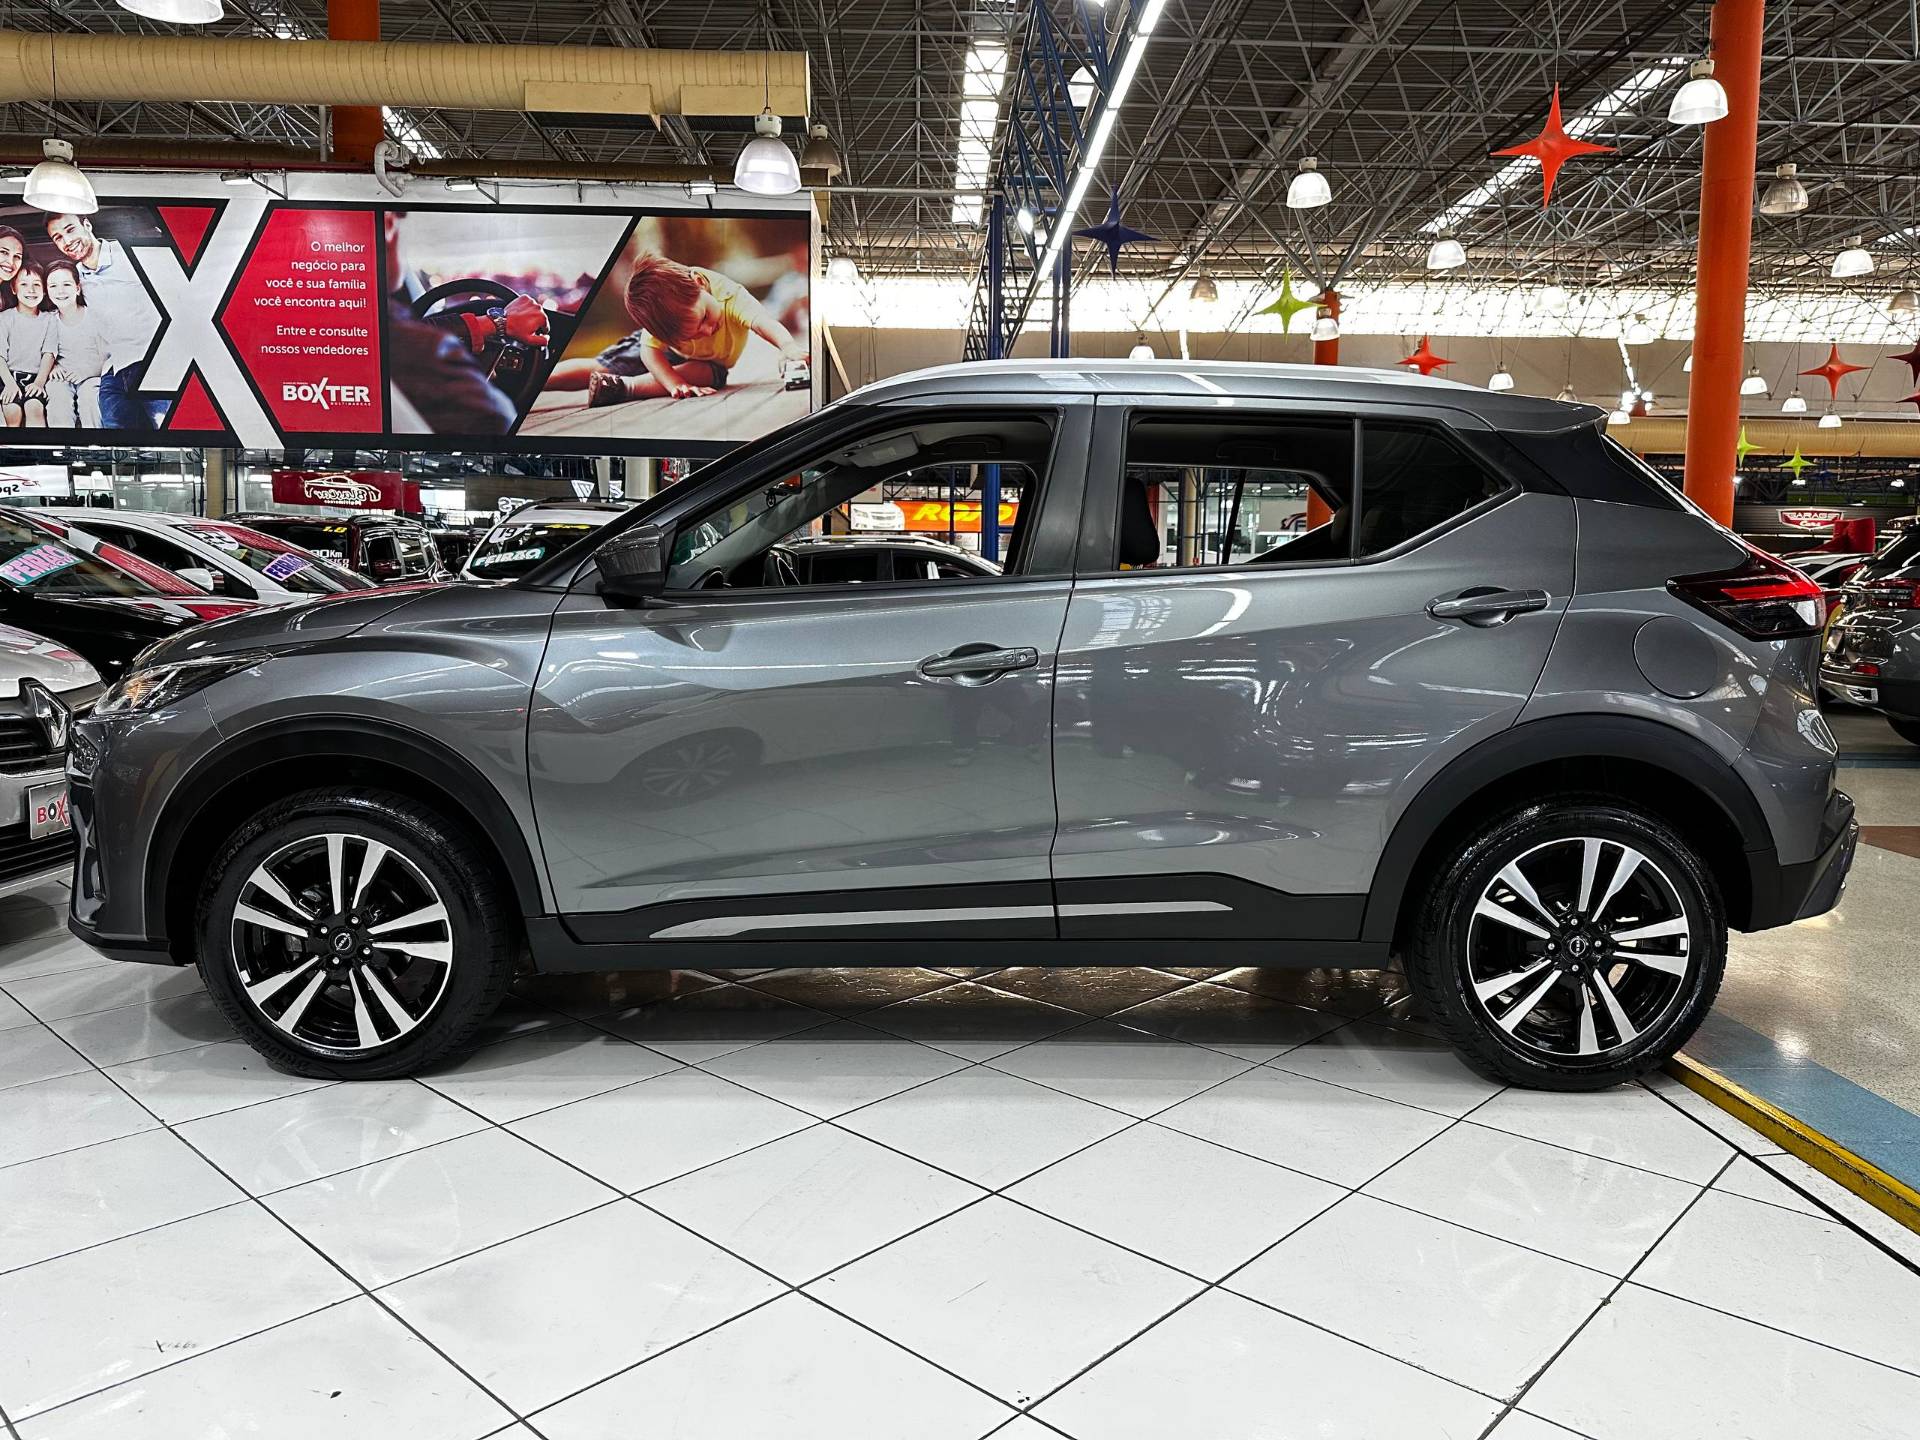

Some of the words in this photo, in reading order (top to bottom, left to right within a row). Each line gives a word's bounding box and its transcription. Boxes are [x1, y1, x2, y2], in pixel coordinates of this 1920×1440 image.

[311, 241, 321, 252] O
[324, 241, 365, 253] melhor
[291, 260, 338, 272] negócio
[340, 262, 366, 273] para
[265, 278, 294, 288] você
[296, 280, 303, 288] e
[306, 280, 326, 289] sua
[328, 278, 366, 290] família
[254, 296, 282, 306] você
[284, 297, 336, 307] encontra
[338, 298, 367, 309] aqui!
[276, 325, 306, 336] Entre
[309, 328, 316, 336] e
[319, 327, 368, 337] consulte
[261, 345, 300, 354] nossos
[303, 345, 369, 356] vendedores
[282, 377, 371, 410] BOXTER
